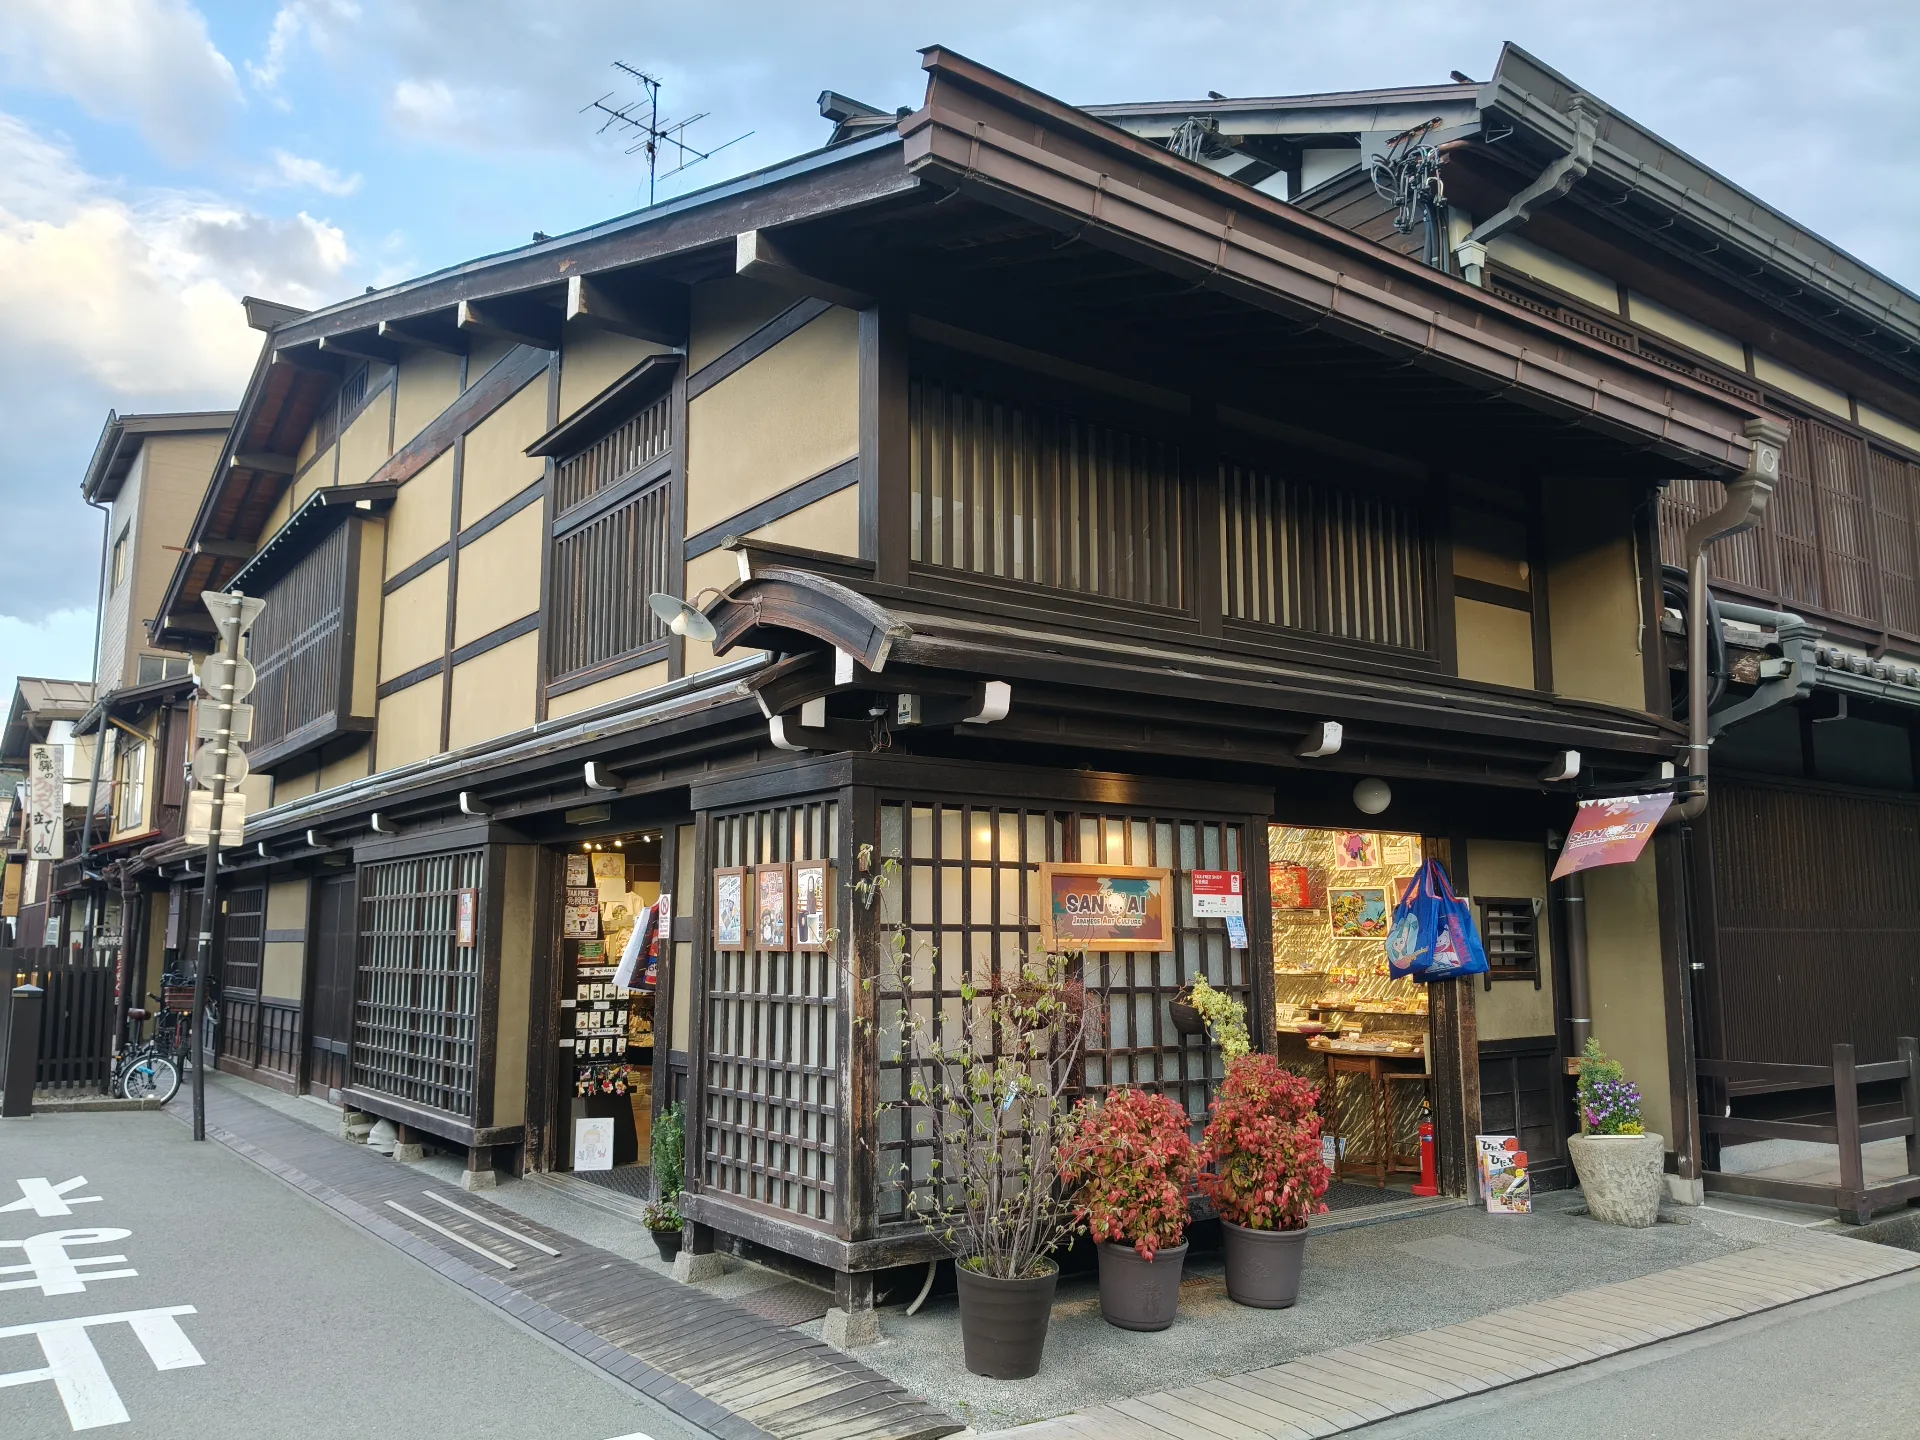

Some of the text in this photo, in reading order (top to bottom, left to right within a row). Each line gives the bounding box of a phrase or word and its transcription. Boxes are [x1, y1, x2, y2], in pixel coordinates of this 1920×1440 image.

[1066, 893, 1105, 914] SAN
[1072, 915, 1142, 926] JAPANESE ART CULTURE
